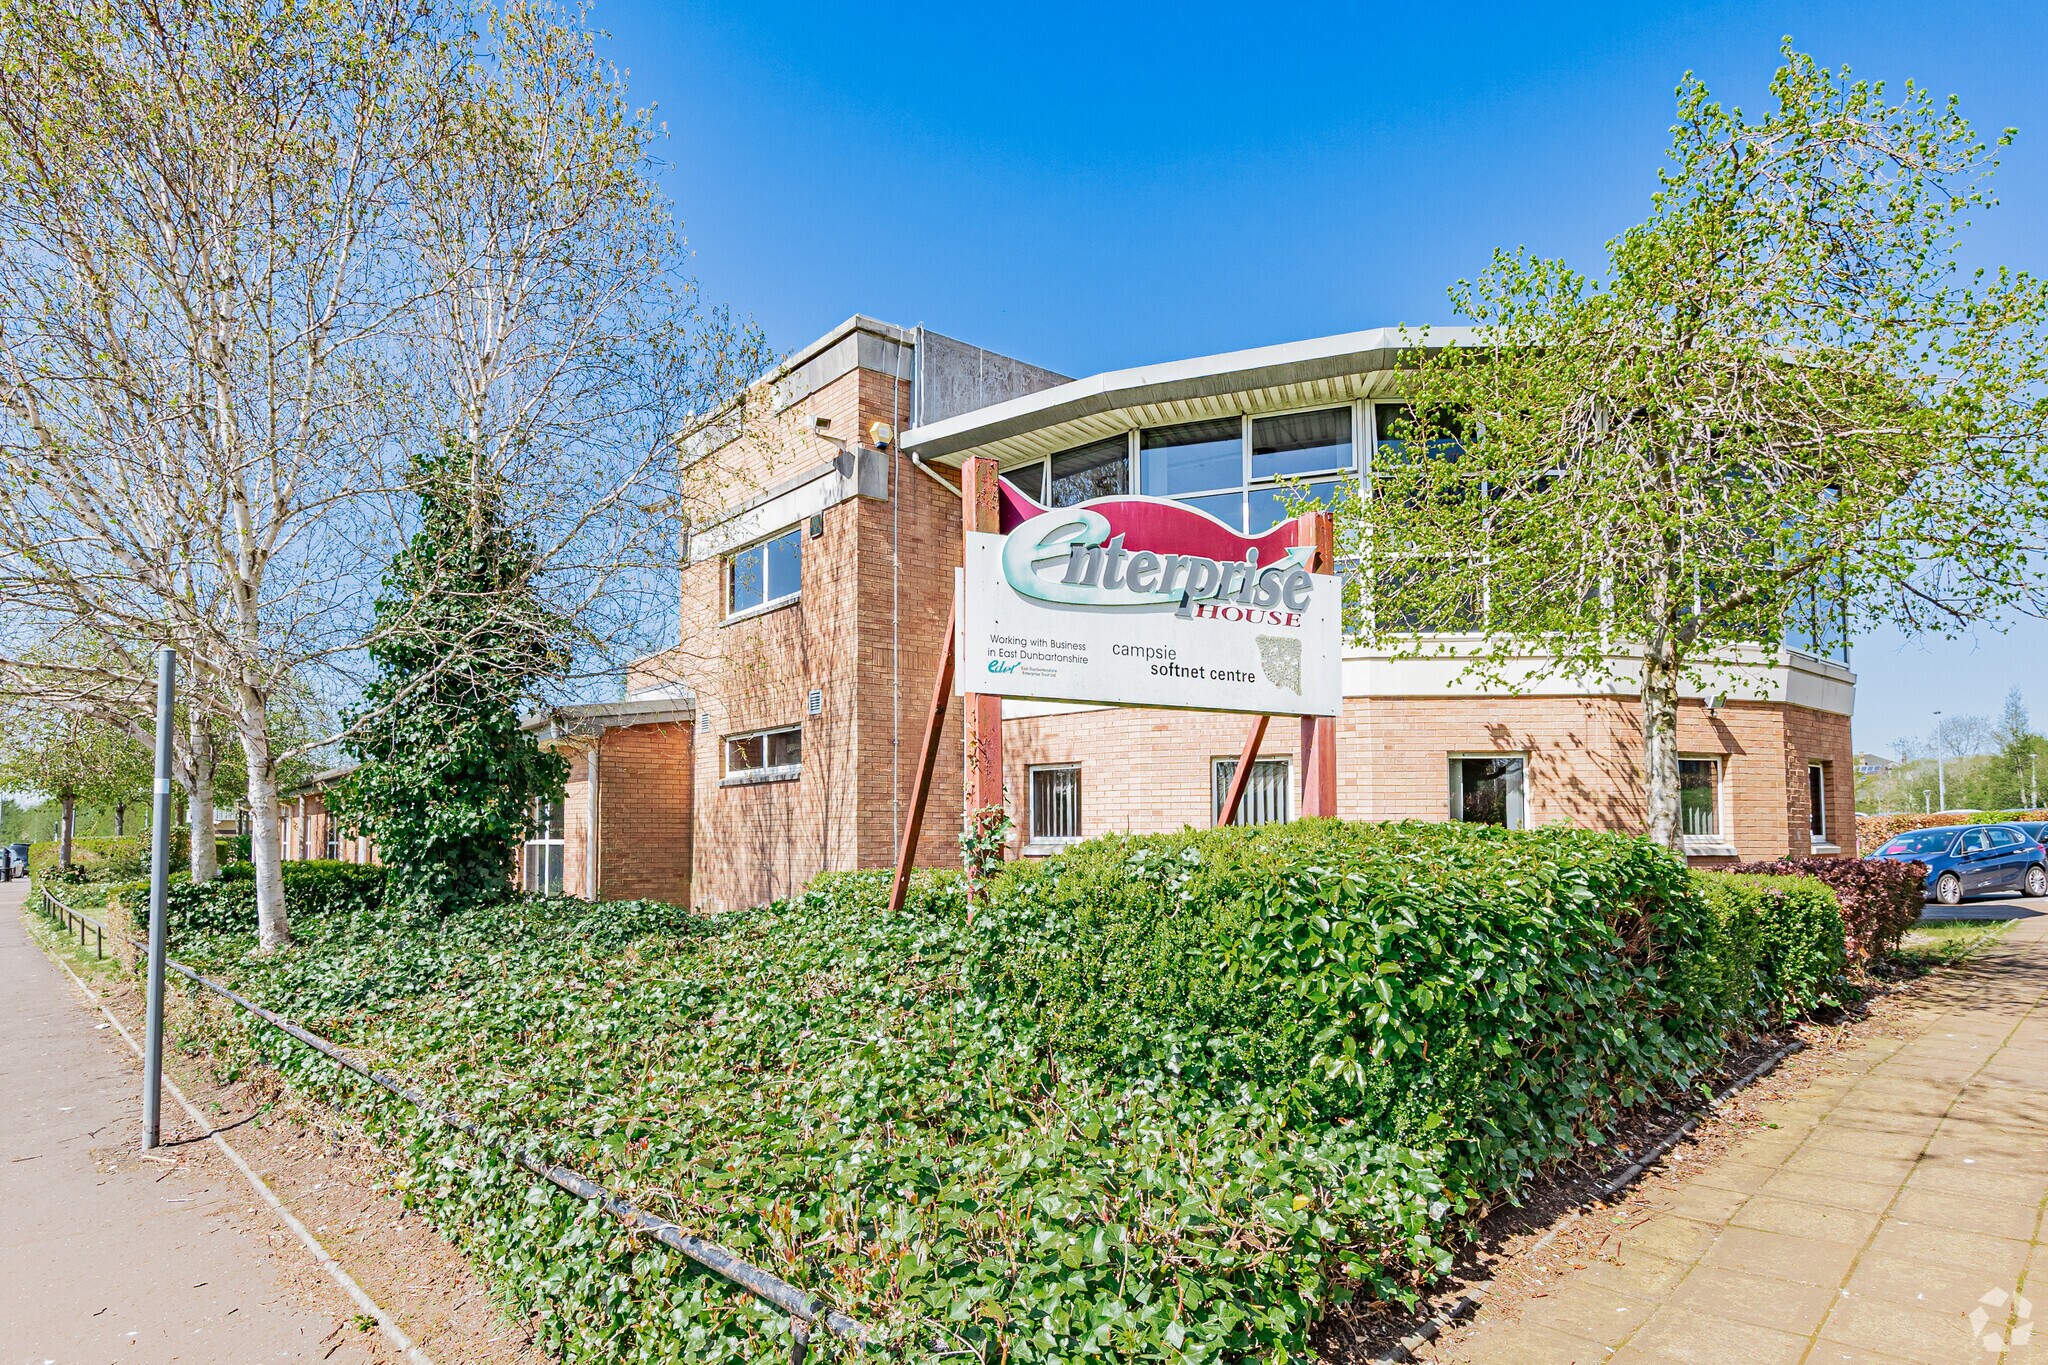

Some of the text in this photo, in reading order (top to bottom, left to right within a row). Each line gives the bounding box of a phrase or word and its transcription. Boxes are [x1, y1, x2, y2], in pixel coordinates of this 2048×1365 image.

[1194, 603, 1302, 628] HOUSE
[989, 633, 1087, 651] Working with Business
[1111, 642, 1177, 661] campsie
[987, 647, 1089, 665] in East Dunbartonshire
[1150, 661, 1256, 683] softnet centre
